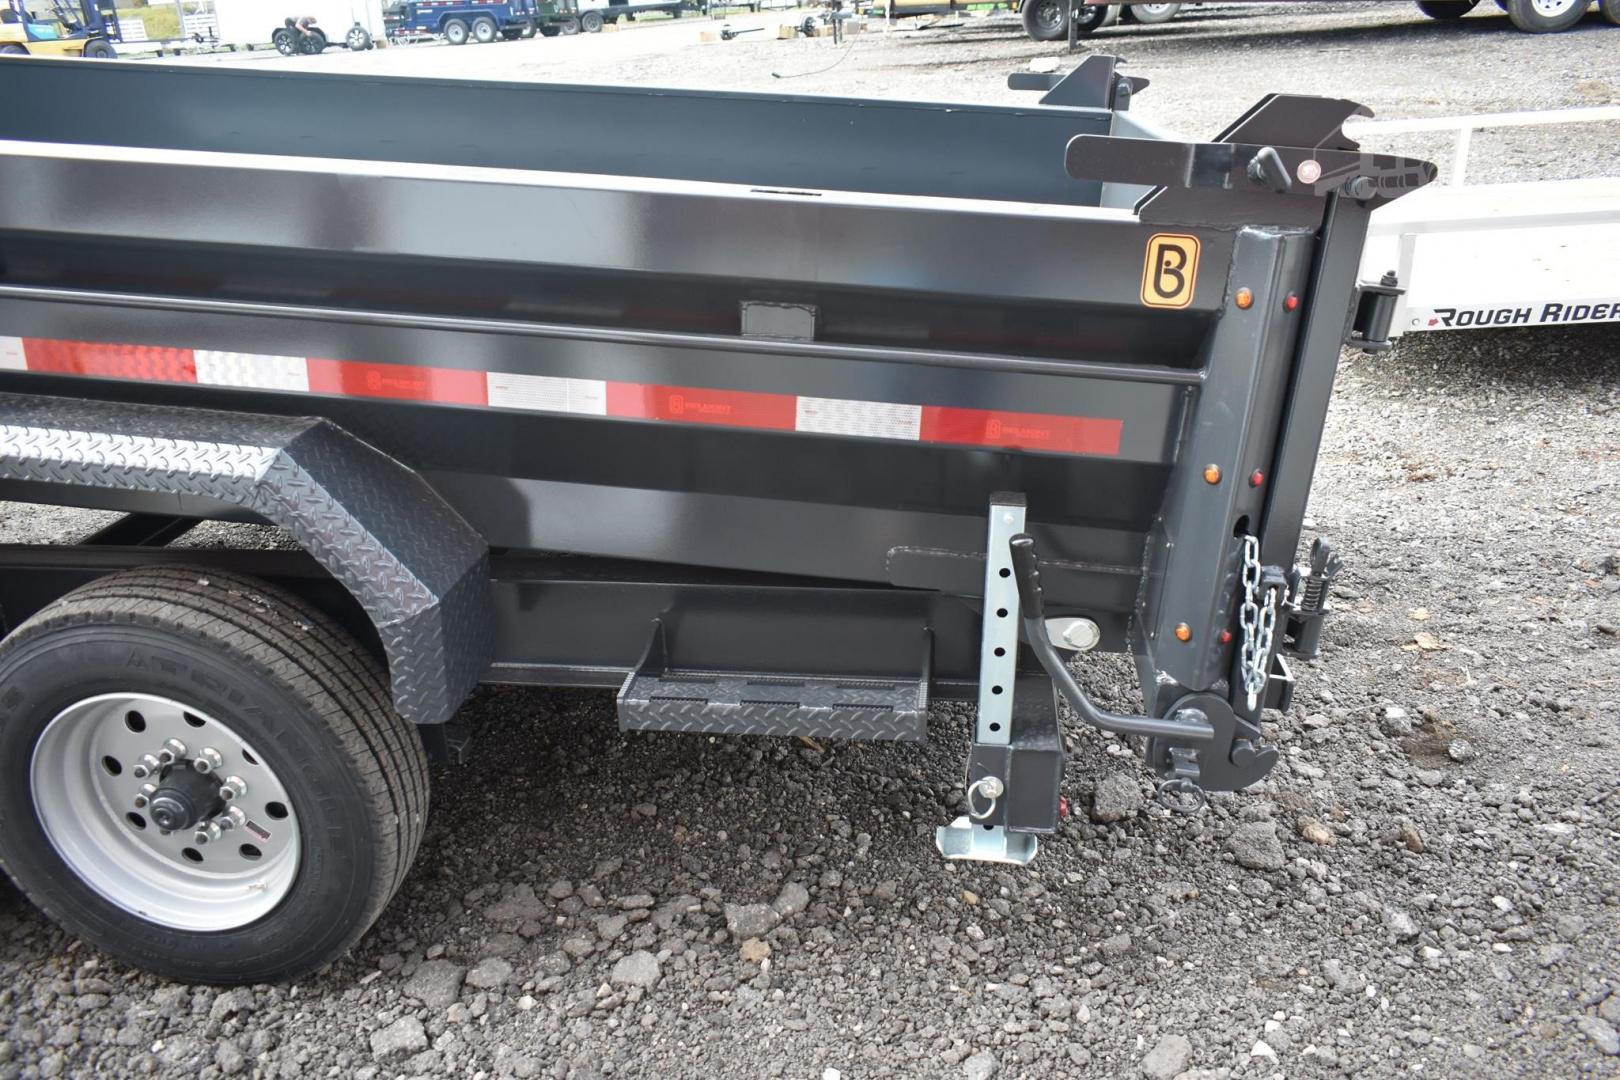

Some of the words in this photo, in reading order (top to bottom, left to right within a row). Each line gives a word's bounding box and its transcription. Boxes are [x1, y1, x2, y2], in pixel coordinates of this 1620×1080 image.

[1153, 243, 1187, 299] B
[1434, 307, 1532, 327] ROUGH
[1539, 303, 1620, 323] RIDER
